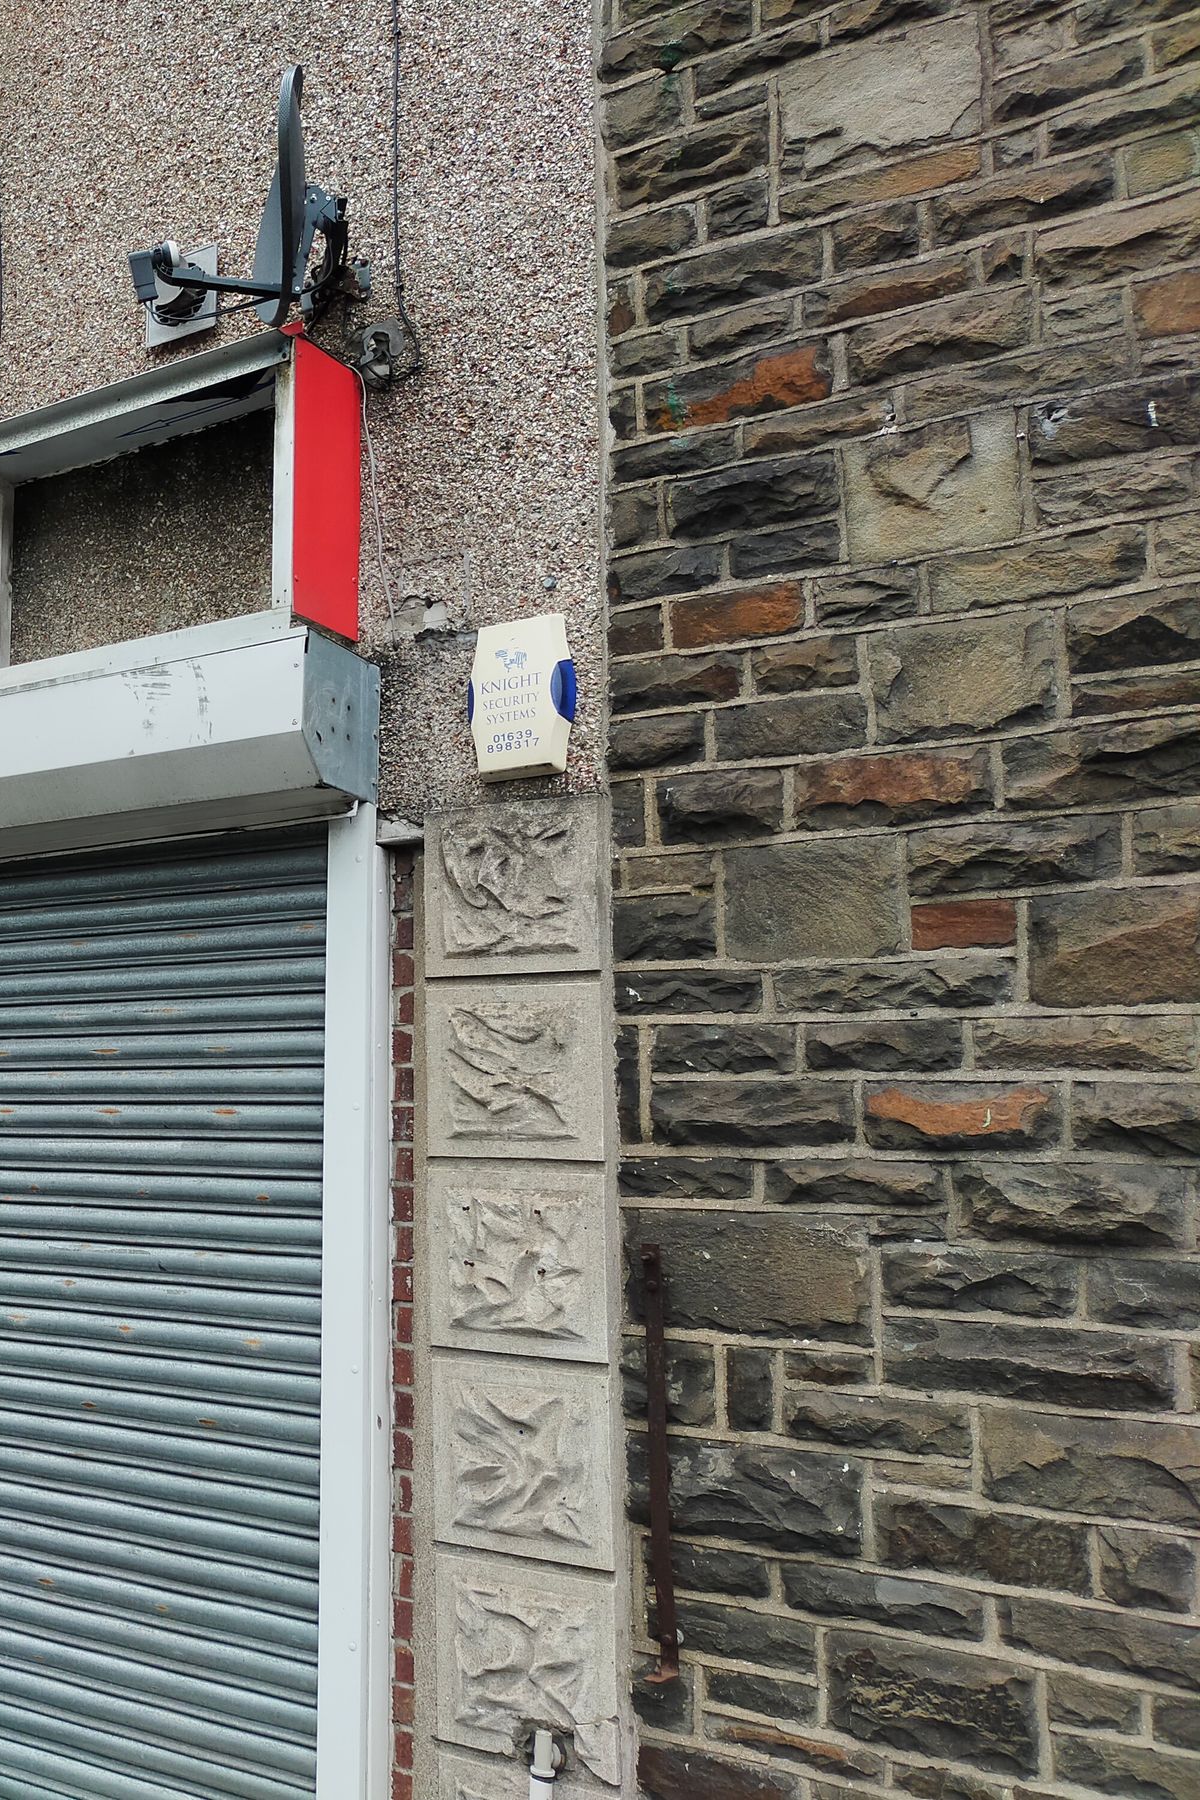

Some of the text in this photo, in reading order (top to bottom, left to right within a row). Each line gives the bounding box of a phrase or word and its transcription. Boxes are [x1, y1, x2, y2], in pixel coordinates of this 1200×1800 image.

[481, 672, 541, 695] KNIGHT
[483, 692, 539, 711] SECURITY
[486, 707, 536, 725] SYSTEMS
[493, 729, 532, 743] 01639
[487, 737, 539, 754] 898317
